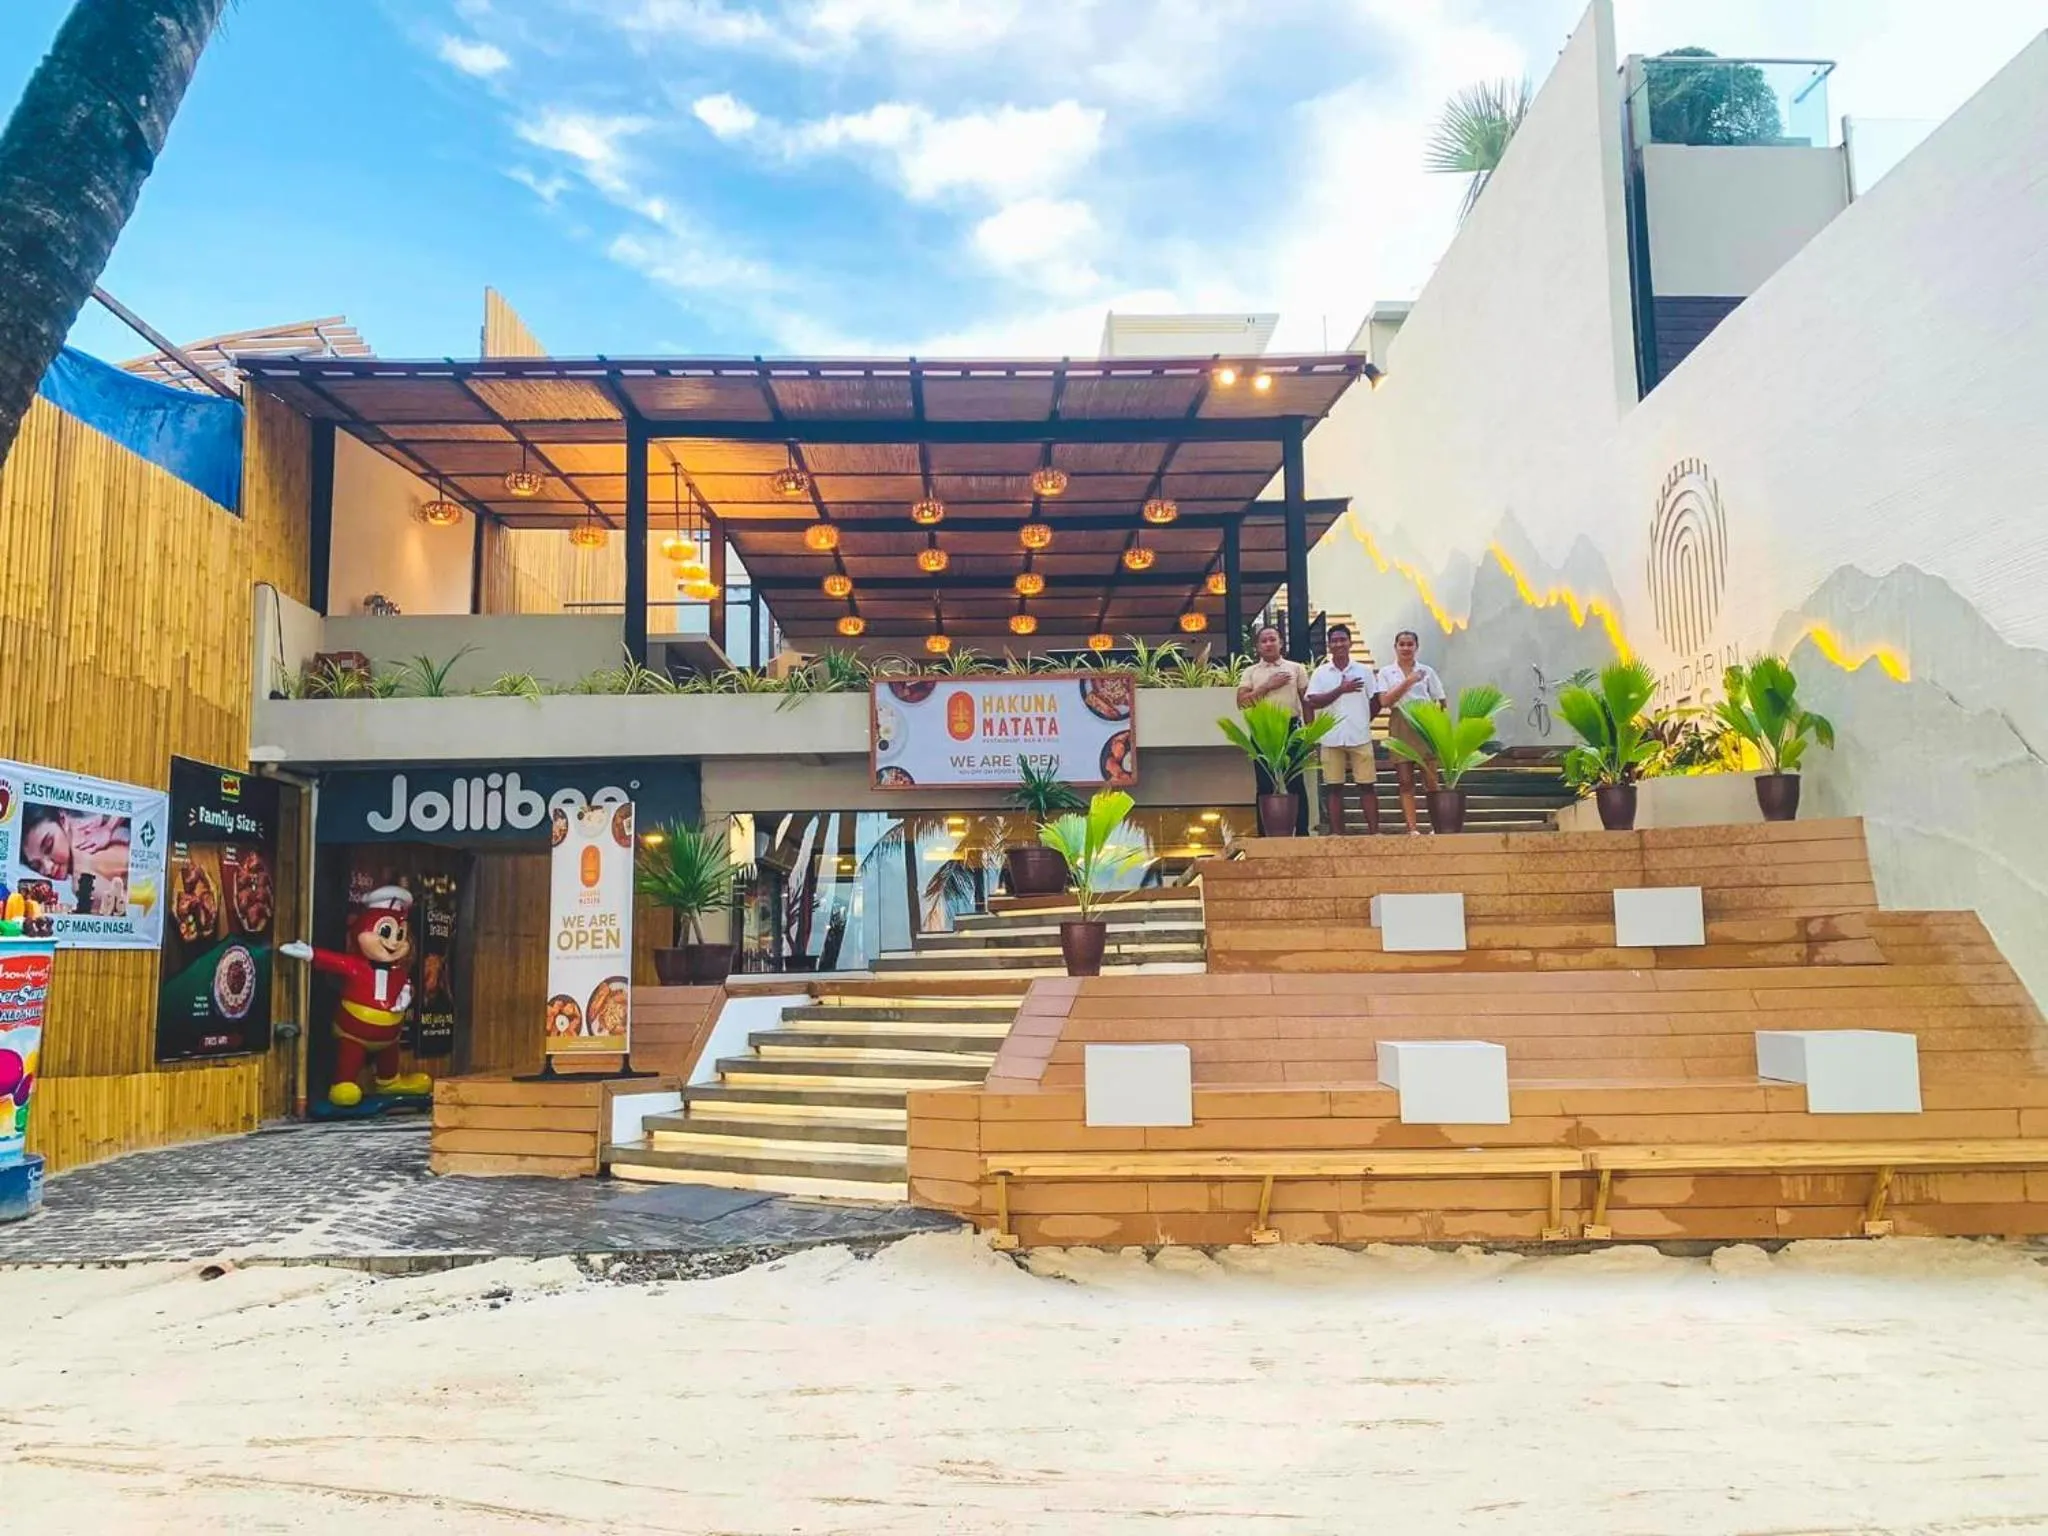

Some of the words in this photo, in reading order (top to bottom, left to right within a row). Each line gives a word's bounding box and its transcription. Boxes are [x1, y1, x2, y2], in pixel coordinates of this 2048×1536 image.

[983, 694, 1058, 713] HAKUNA
[983, 717, 1059, 736] MATATA
[950, 755, 976, 768] WE
[980, 754, 1012, 767] ARE
[1016, 753, 1060, 767] OPEN
[24, 782, 75, 804] EASTMAN
[75, 791, 94, 807] SPA
[199, 806, 235, 834] Family
[236, 813, 257, 833] Size
[56, 919, 71, 933] OF
[72, 920, 102, 933] MANG
[103, 921, 135, 934] INASAL
[562, 914, 585, 929] WE
[588, 913, 617, 927] ARE
[557, 928, 621, 951] OPEN
